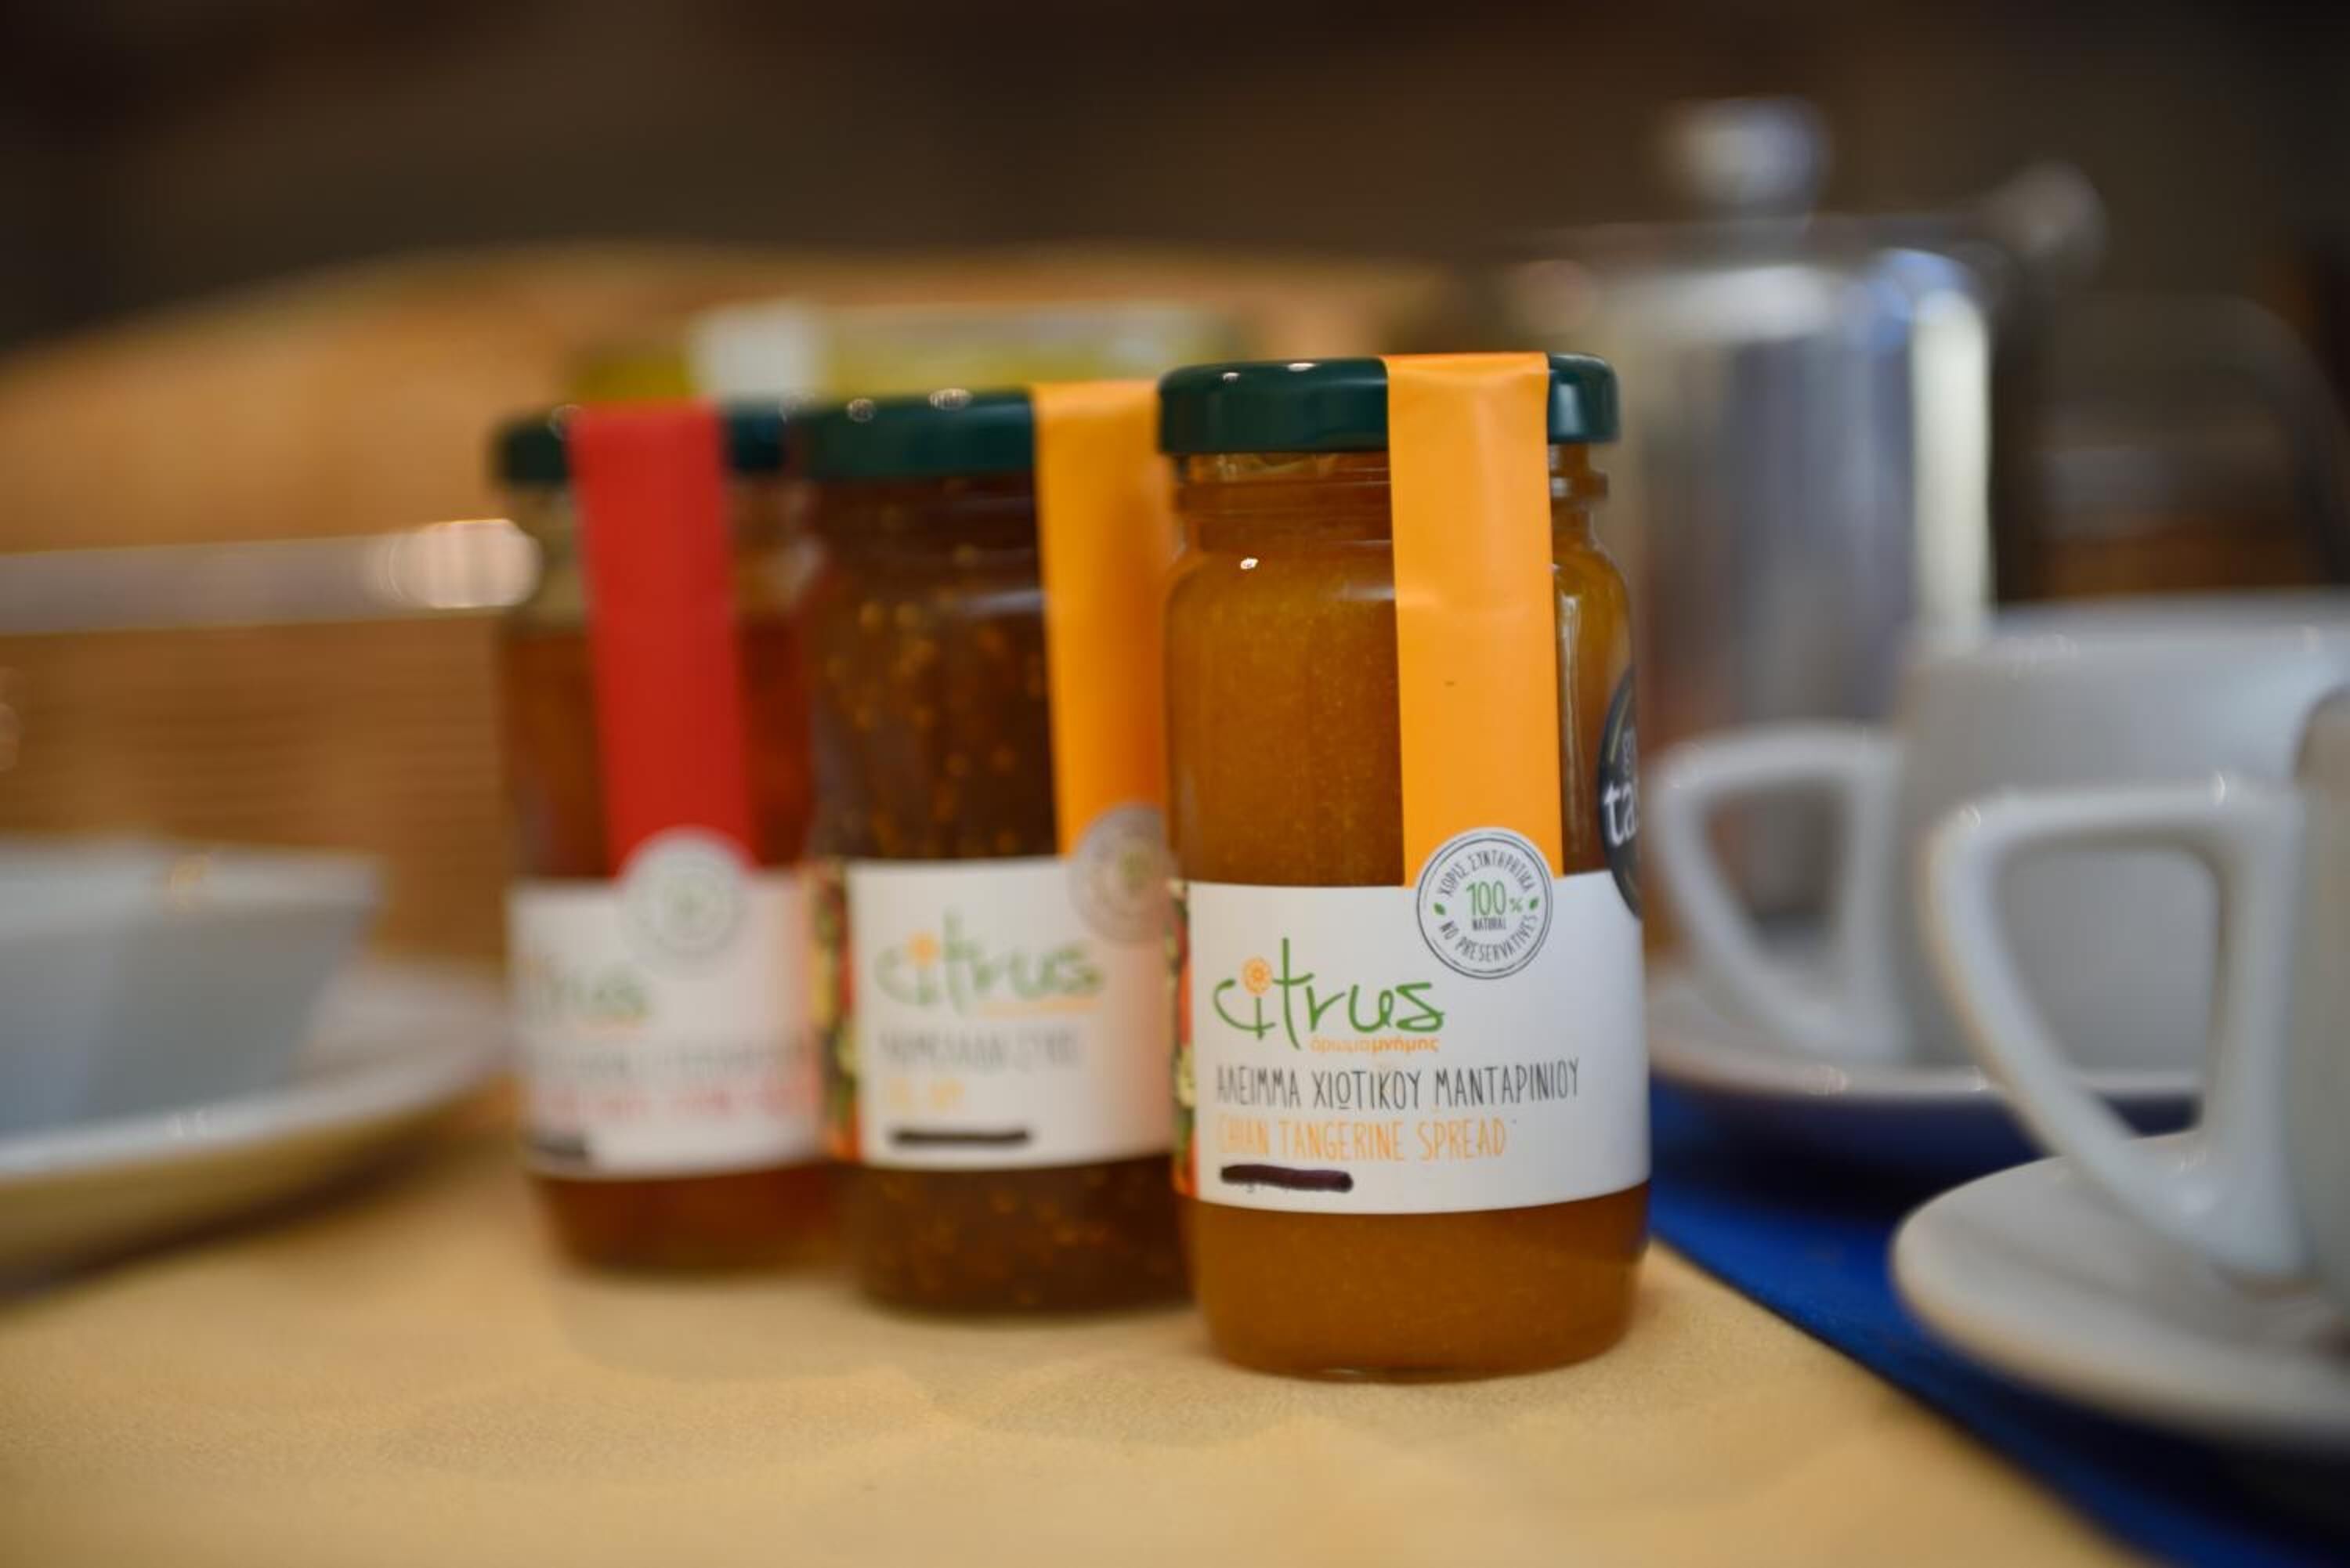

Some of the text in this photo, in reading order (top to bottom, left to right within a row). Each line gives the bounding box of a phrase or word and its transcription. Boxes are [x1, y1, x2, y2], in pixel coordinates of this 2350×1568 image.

[1439, 914, 1538, 963] NO PRESERVATIVES
[1472, 917, 1507, 931] NATURAL
[1213, 938, 1445, 1050] citrus
[1434, 1057, 1580, 1107] ΜΑΝΤΑΡΙΝΙΟΥ
[1278, 1118, 1405, 1162] TANGERINE
[1415, 1115, 1506, 1162] SPREAD
